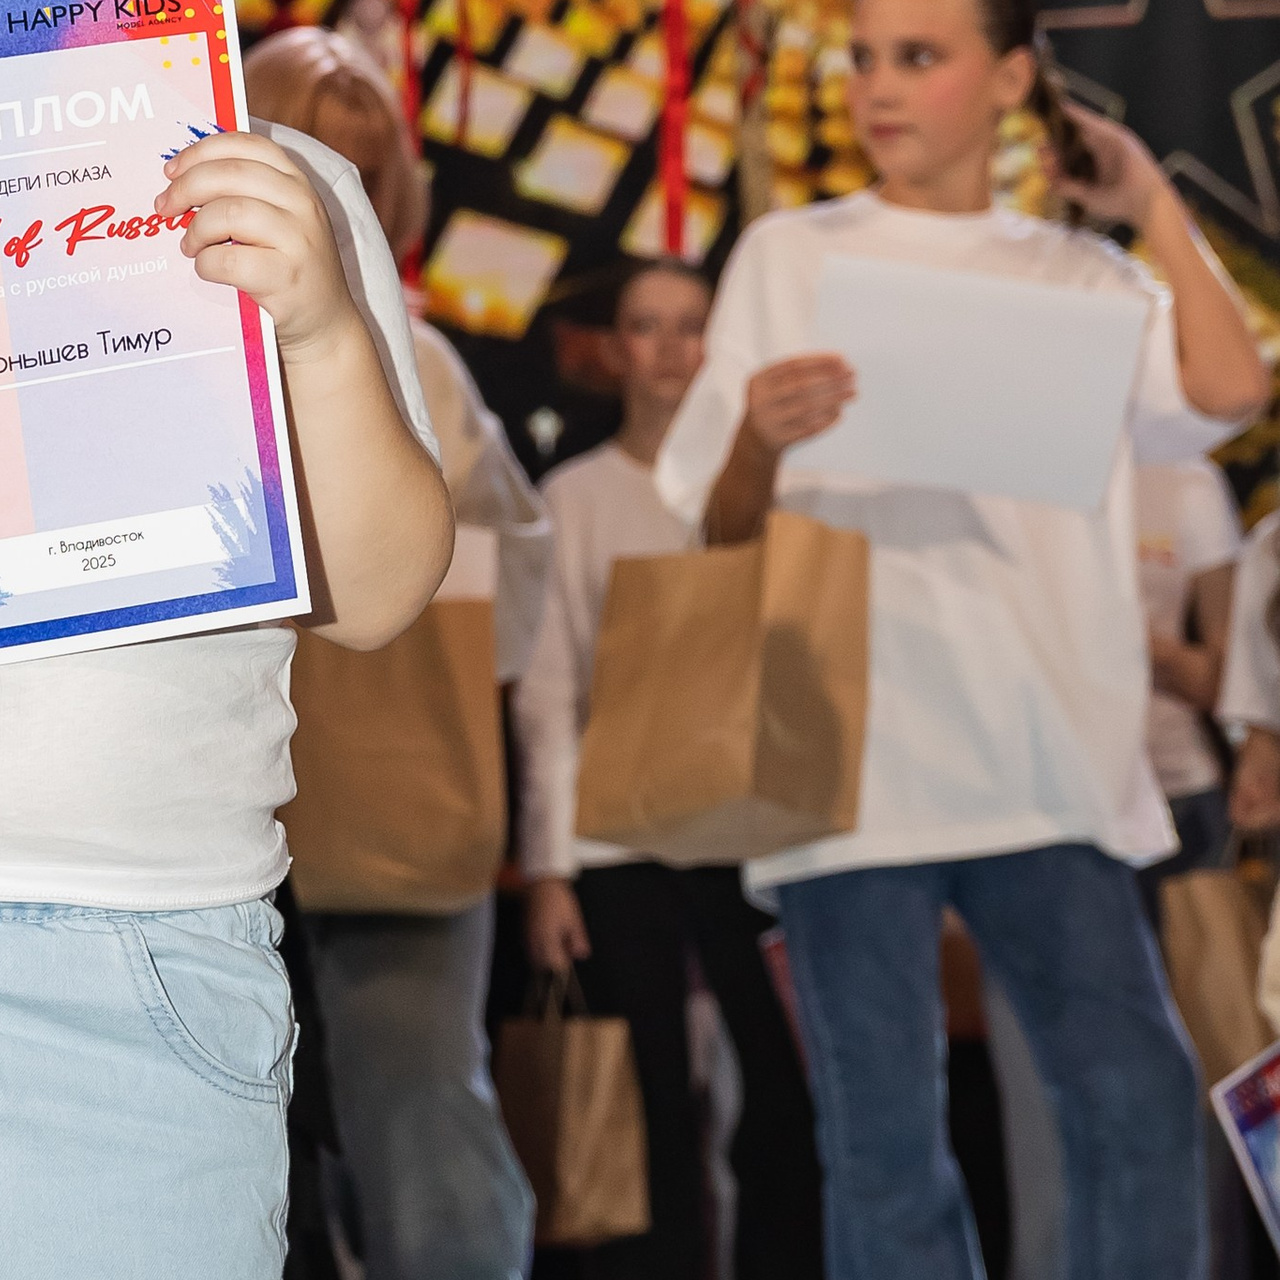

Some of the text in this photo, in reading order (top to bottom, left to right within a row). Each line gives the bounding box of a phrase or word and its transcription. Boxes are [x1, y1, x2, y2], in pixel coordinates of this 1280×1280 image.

[7, 0, 104, 34] HAPPY
[116, 20, 145, 30] MODEL
[45, 165, 112, 188] ПОКАЗА
[3, 220, 43, 268] of
[10, 282, 22, 296] с
[25, 267, 102, 298] русской
[106, 256, 168, 282] душой
[96, 328, 172, 355] Тимур
[48, 532, 145, 556] г. Владивосток
[81, 554, 117, 572] 2025
